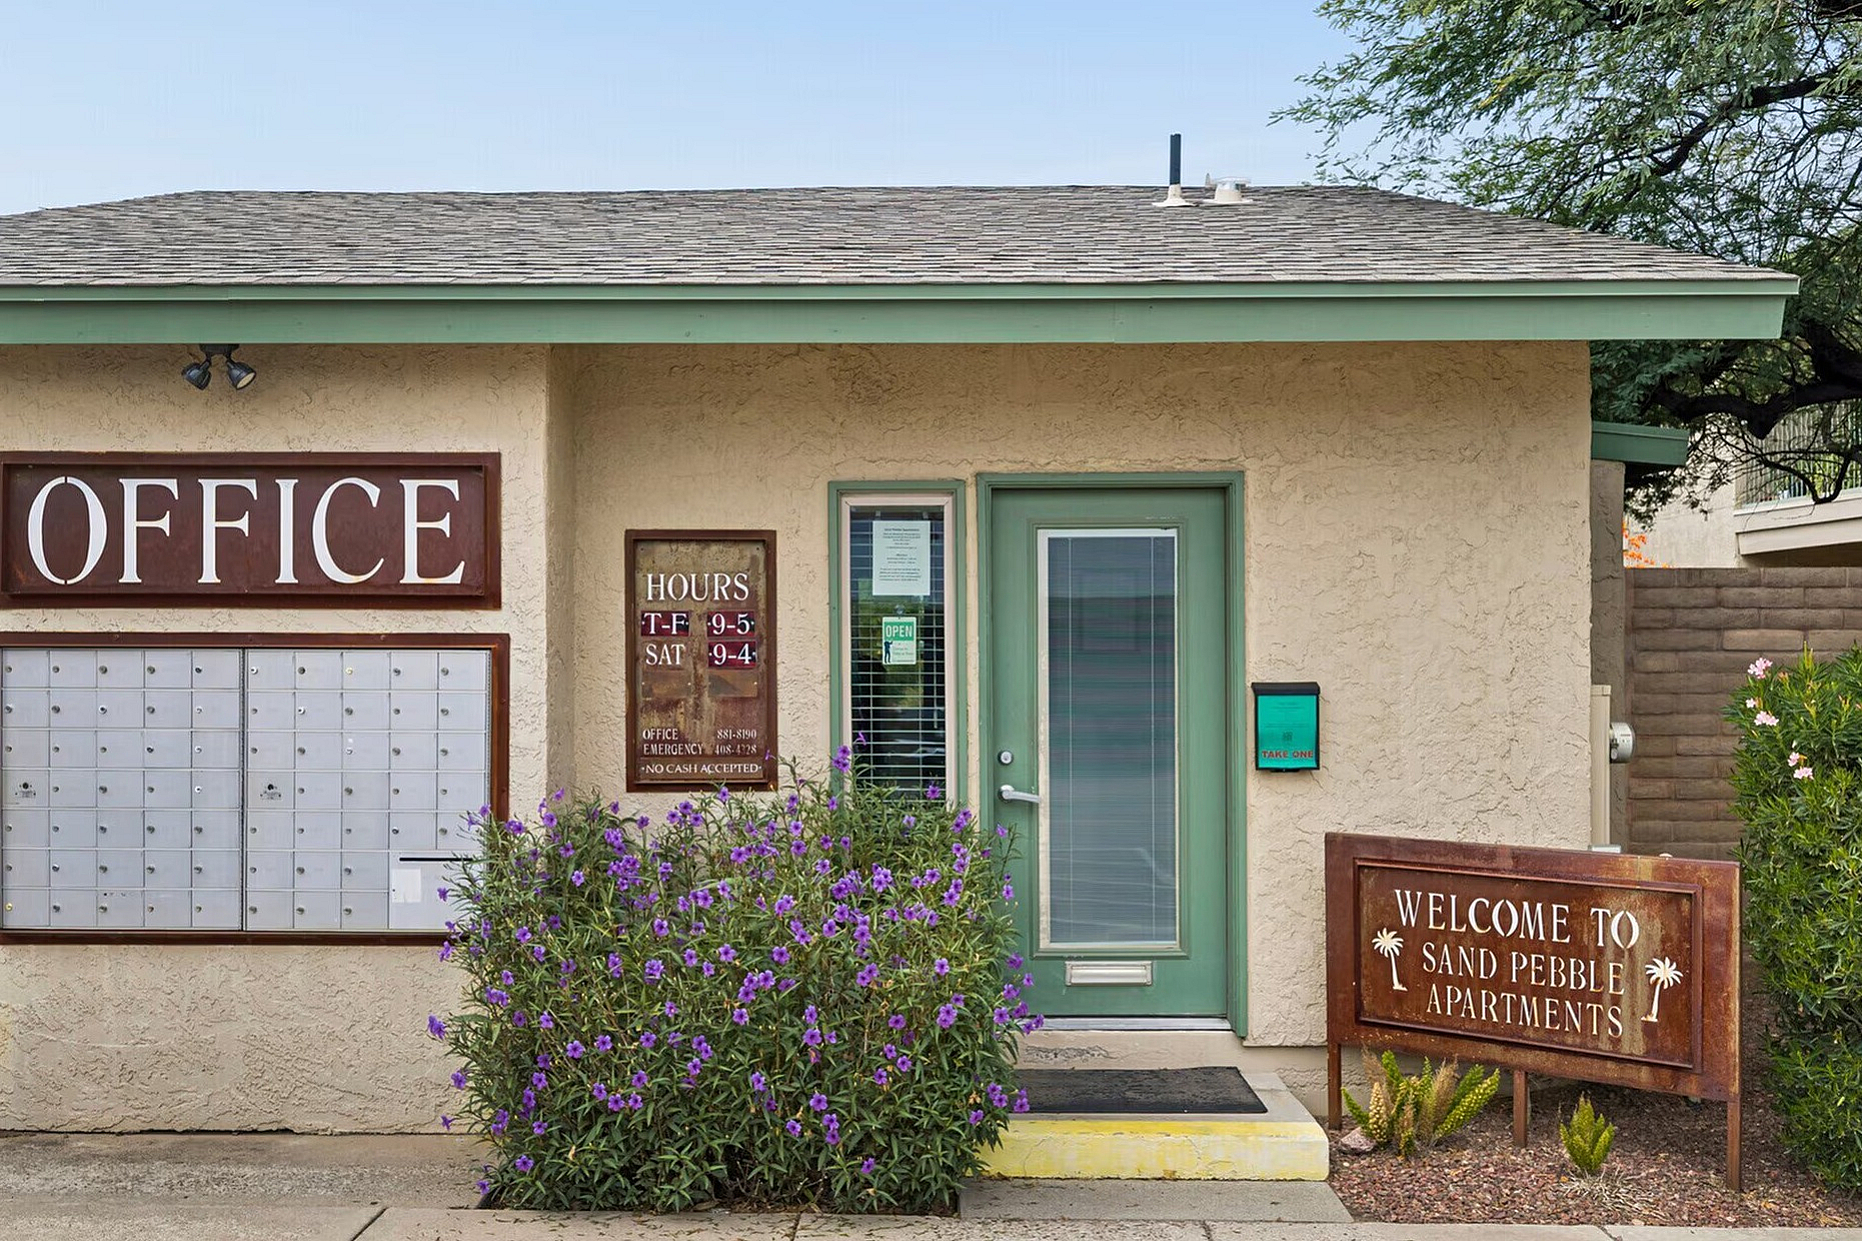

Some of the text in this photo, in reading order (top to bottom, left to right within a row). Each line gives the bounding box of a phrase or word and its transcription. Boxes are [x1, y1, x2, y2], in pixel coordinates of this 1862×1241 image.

[27, 475, 465, 585] OFFICE
[646, 573, 749, 601] HOURS
[643, 612, 751, 635] T-F 9-5
[885, 625, 913, 638] OPEN
[645, 643, 752, 665] SAT 9-4
[642, 728, 678, 740] OFFICE
[643, 743, 703, 755] EMERGENCY
[1262, 750, 1313, 758] TAKE ONE
[645, 763, 759, 774] NO CASH ACCEPTED
[1394, 888, 1640, 950] WELCOME TO
[1422, 941, 1625, 995] SAND PEBBLE
[1426, 983, 1623, 1038] APARTMENTS
